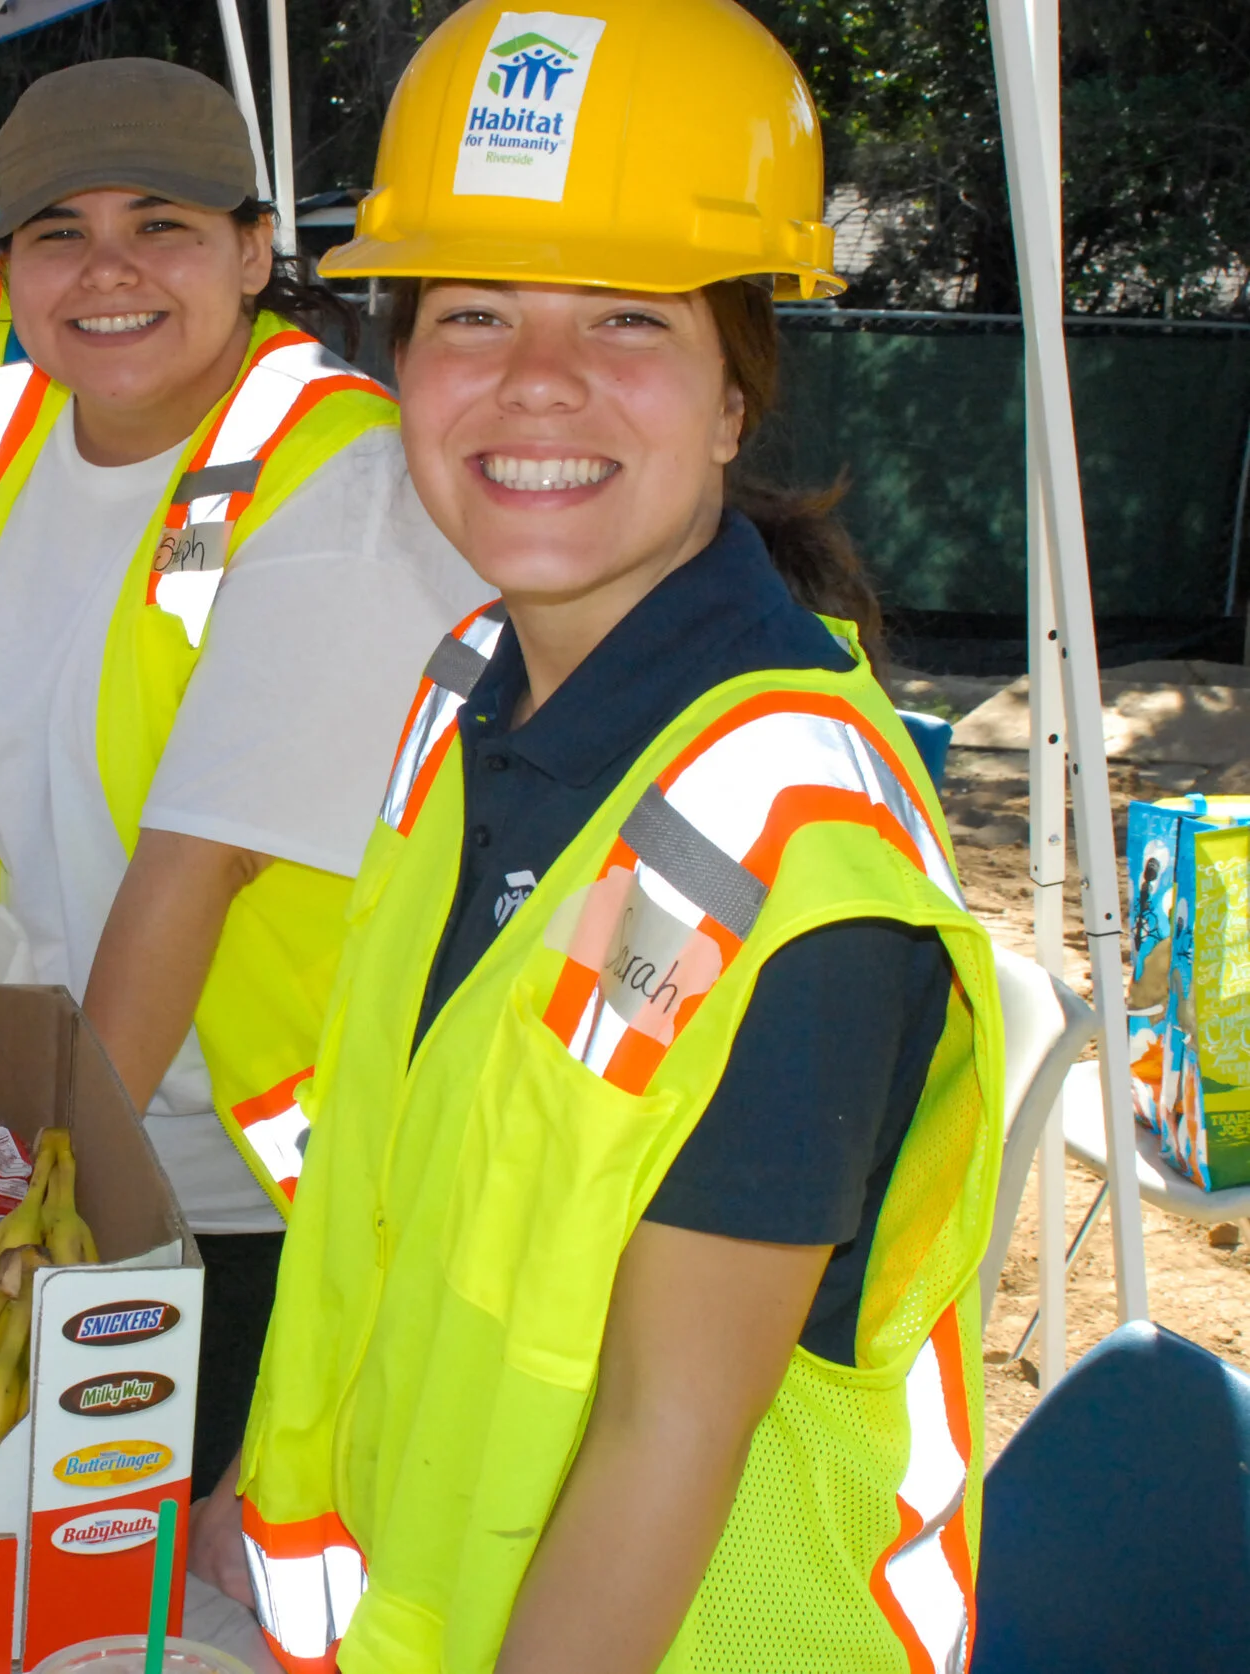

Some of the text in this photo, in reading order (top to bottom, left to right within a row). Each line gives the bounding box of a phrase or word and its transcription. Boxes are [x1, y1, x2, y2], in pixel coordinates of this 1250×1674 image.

[468, 106, 564, 136] Habitat
[464, 133, 559, 155] for Humanity
[485, 151, 534, 166] Riverside
[80, 1308, 163, 1337] SNICKERS
[64, 1451, 163, 1477] Butterfinger
